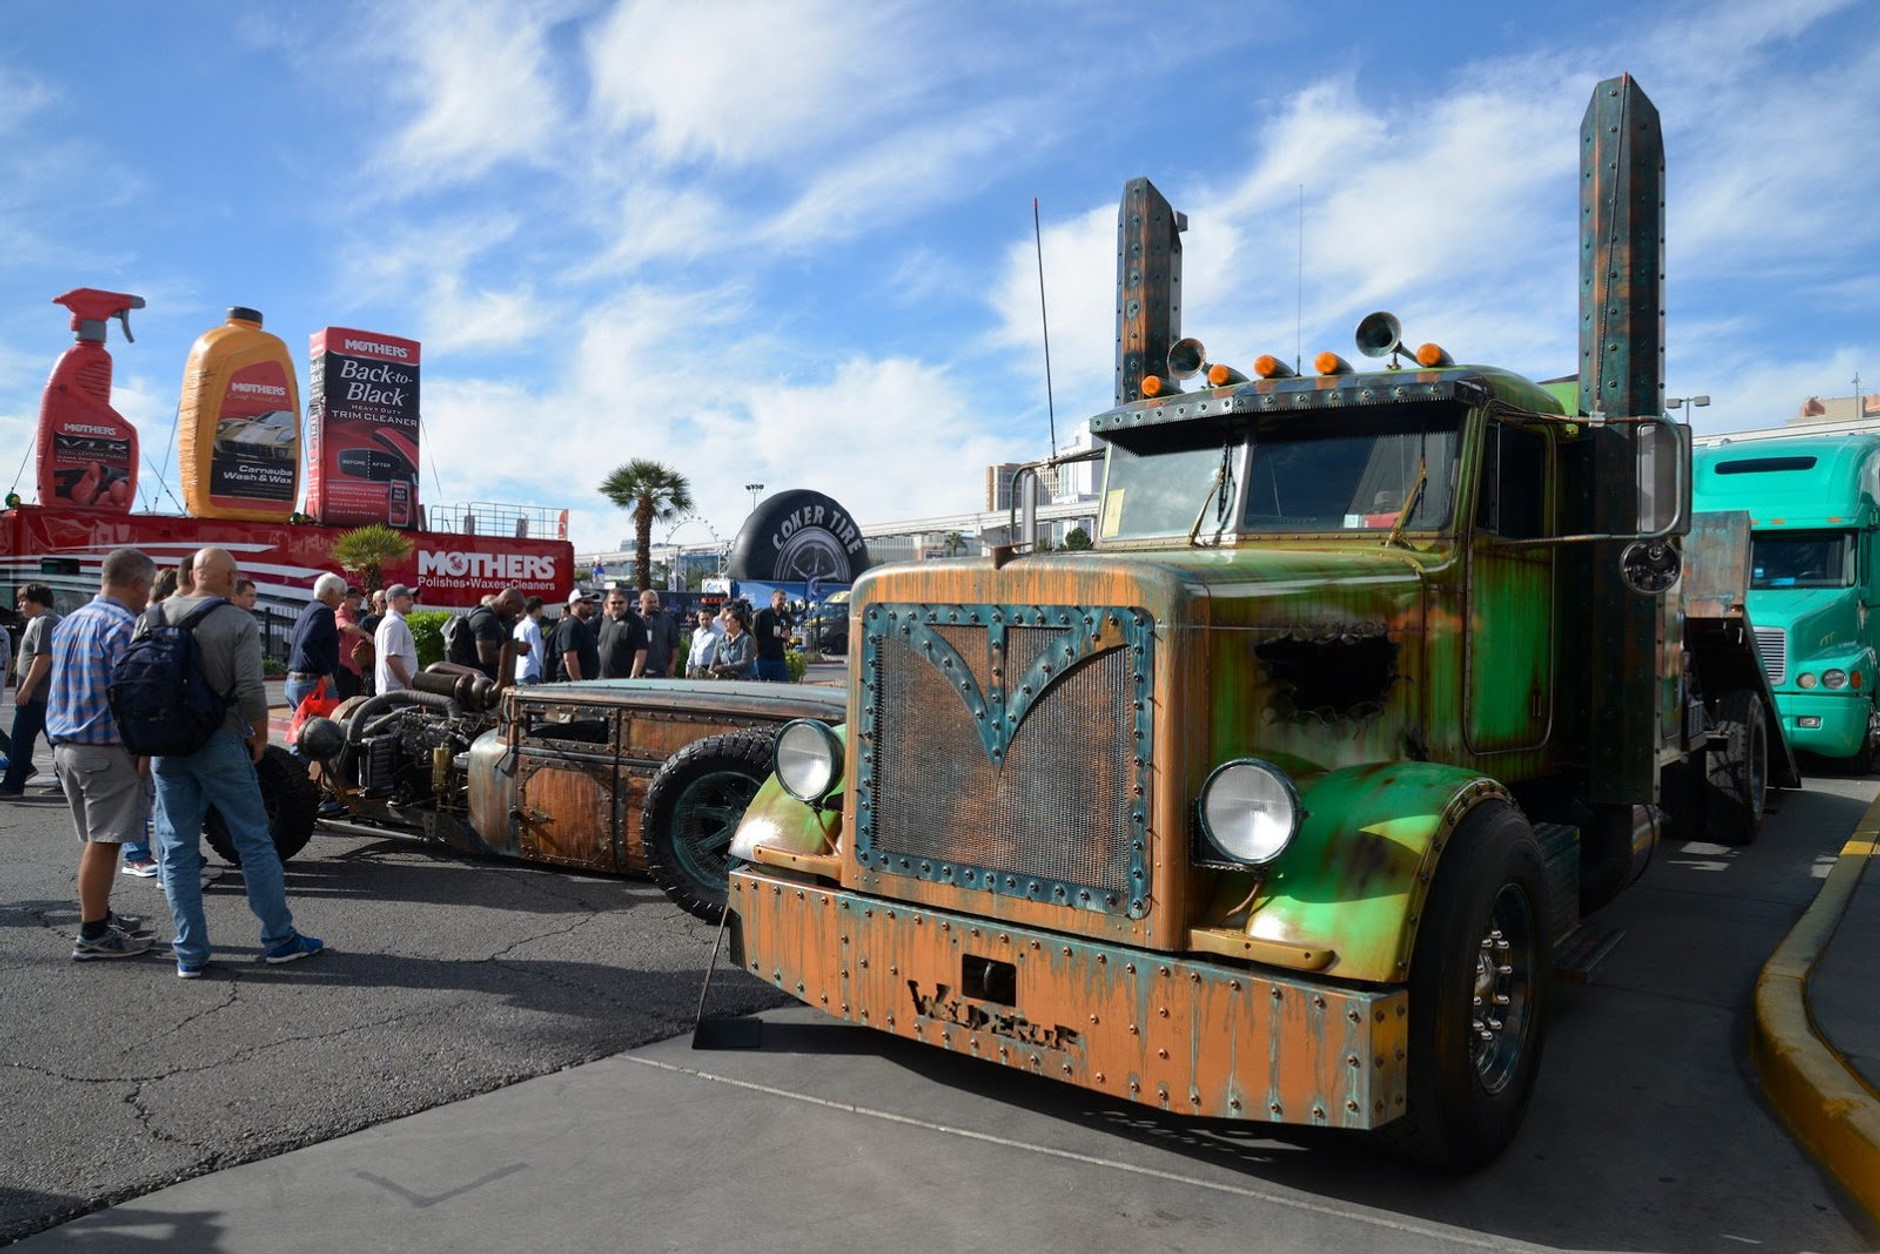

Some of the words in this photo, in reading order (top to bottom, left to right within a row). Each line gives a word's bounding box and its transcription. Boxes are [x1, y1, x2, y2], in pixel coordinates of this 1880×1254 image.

[344, 339, 408, 358] MOTHERS
[231, 382, 286, 396] MOTHERS
[346, 381, 405, 407] Black
[351, 404, 378, 412] HEAVY
[380, 407, 401, 415] DUTY
[332, 410, 361, 419] TRIM
[364, 413, 418, 427] CLEANER
[64, 423, 116, 435] MOTHERS
[223, 471, 257, 481] Wash
[258, 473, 268, 482] &
[269, 475, 292, 484] Wax
[239, 465, 293, 476] Carnauba
[772, 505, 825, 551] COKER
[829, 510, 863, 555] TIRE
[418, 550, 556, 580] MOTHERS
